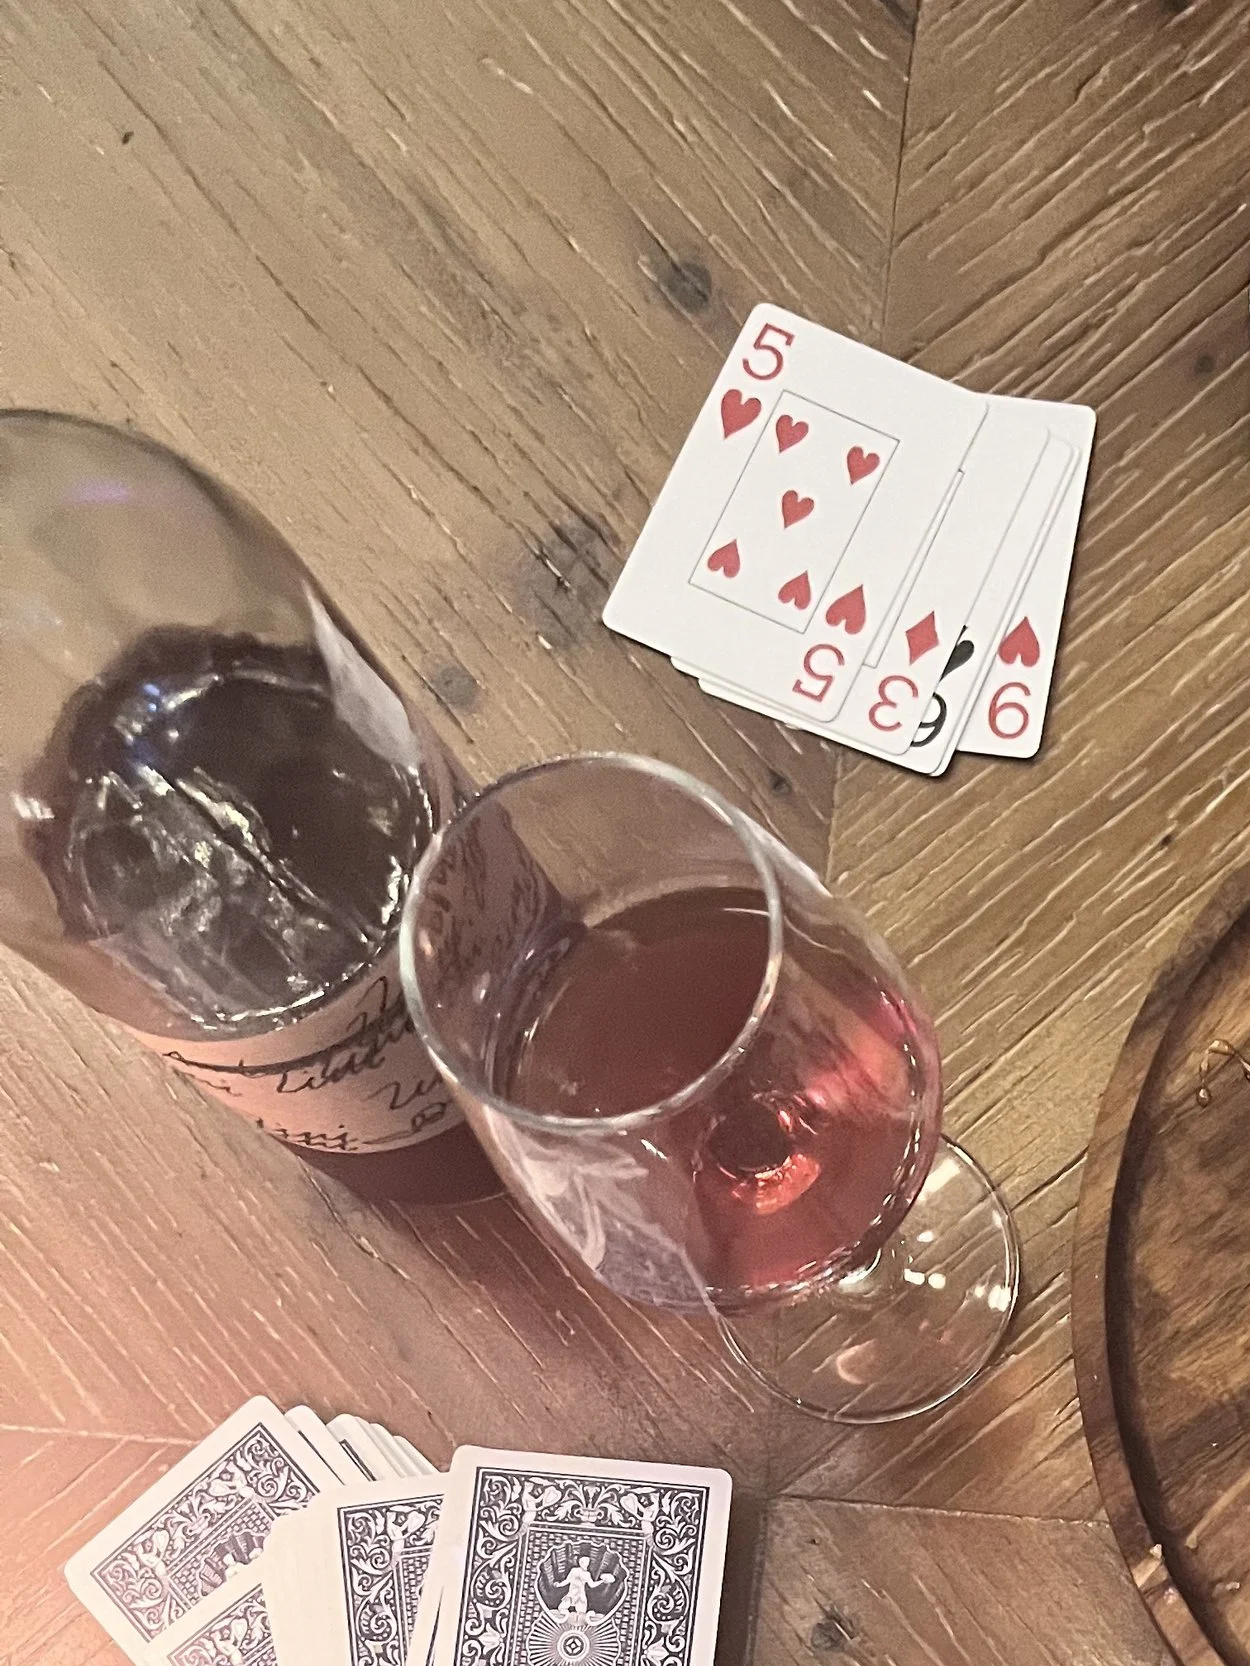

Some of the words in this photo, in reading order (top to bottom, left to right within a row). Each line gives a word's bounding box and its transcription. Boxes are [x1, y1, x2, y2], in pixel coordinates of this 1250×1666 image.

[742, 323, 795, 380] 5
[792, 643, 845, 701] 5
[868, 674, 919, 731] 3
